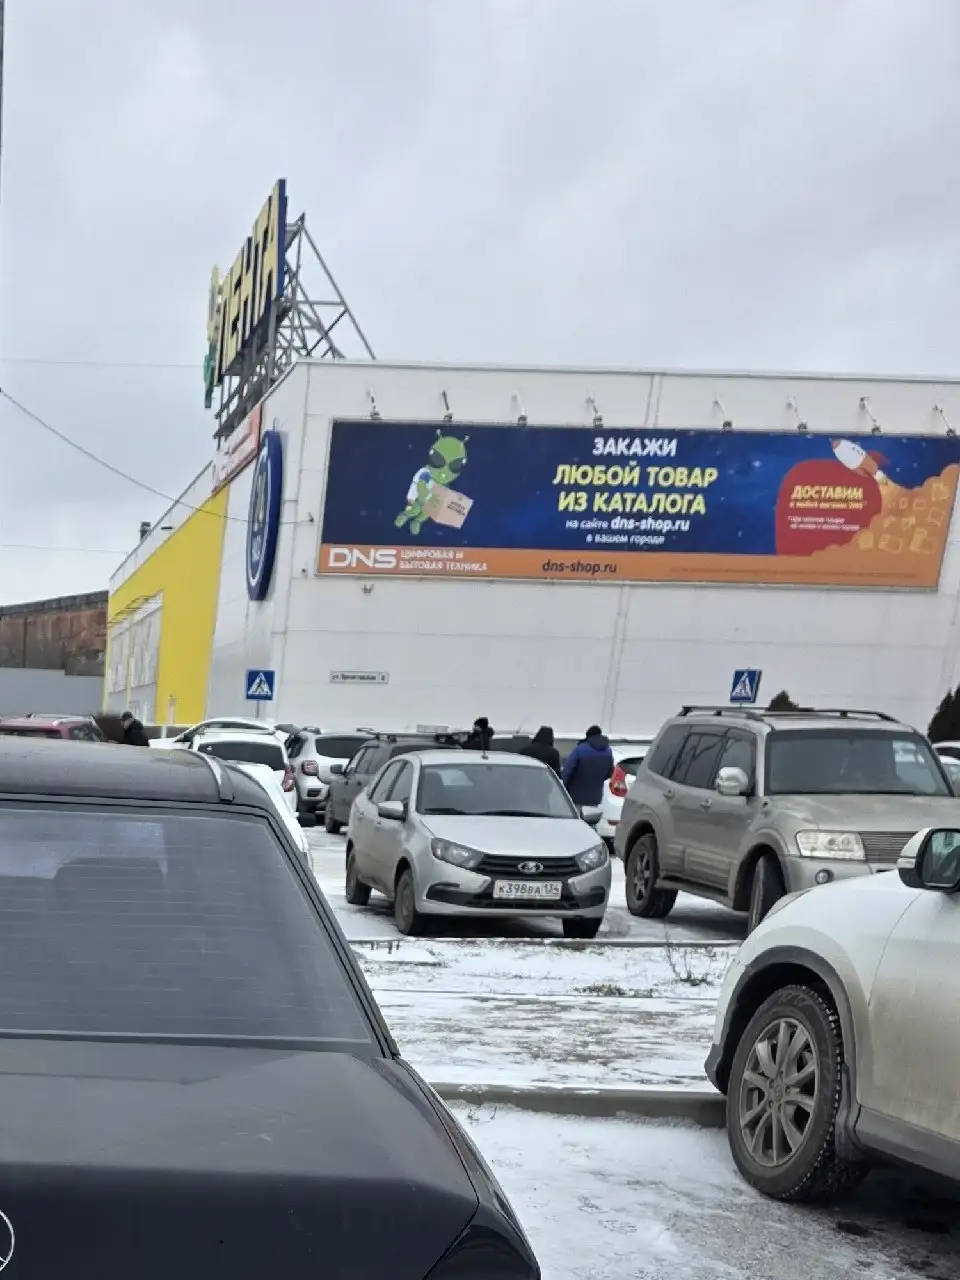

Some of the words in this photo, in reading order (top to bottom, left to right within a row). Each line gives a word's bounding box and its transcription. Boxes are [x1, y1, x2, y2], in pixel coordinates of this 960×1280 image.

[213, 178, 286, 387] ЛЕНТА
[592, 437, 677, 456] ЗАКАЖИ
[552, 460, 640, 487] ЛЮБОЙ
[646, 466, 718, 487] ТОВАР
[791, 485, 863, 500] ДОСТАВИМ
[558, 491, 588, 512] ИЗ
[593, 492, 706, 514] КАТАЛОГА
[610, 516, 690, 533] dns-shop.ru
[328, 548, 397, 569] DNS
[446, 562, 488, 571] ТЕХНИКА
[542, 560, 617, 574] dns-shop.ru
